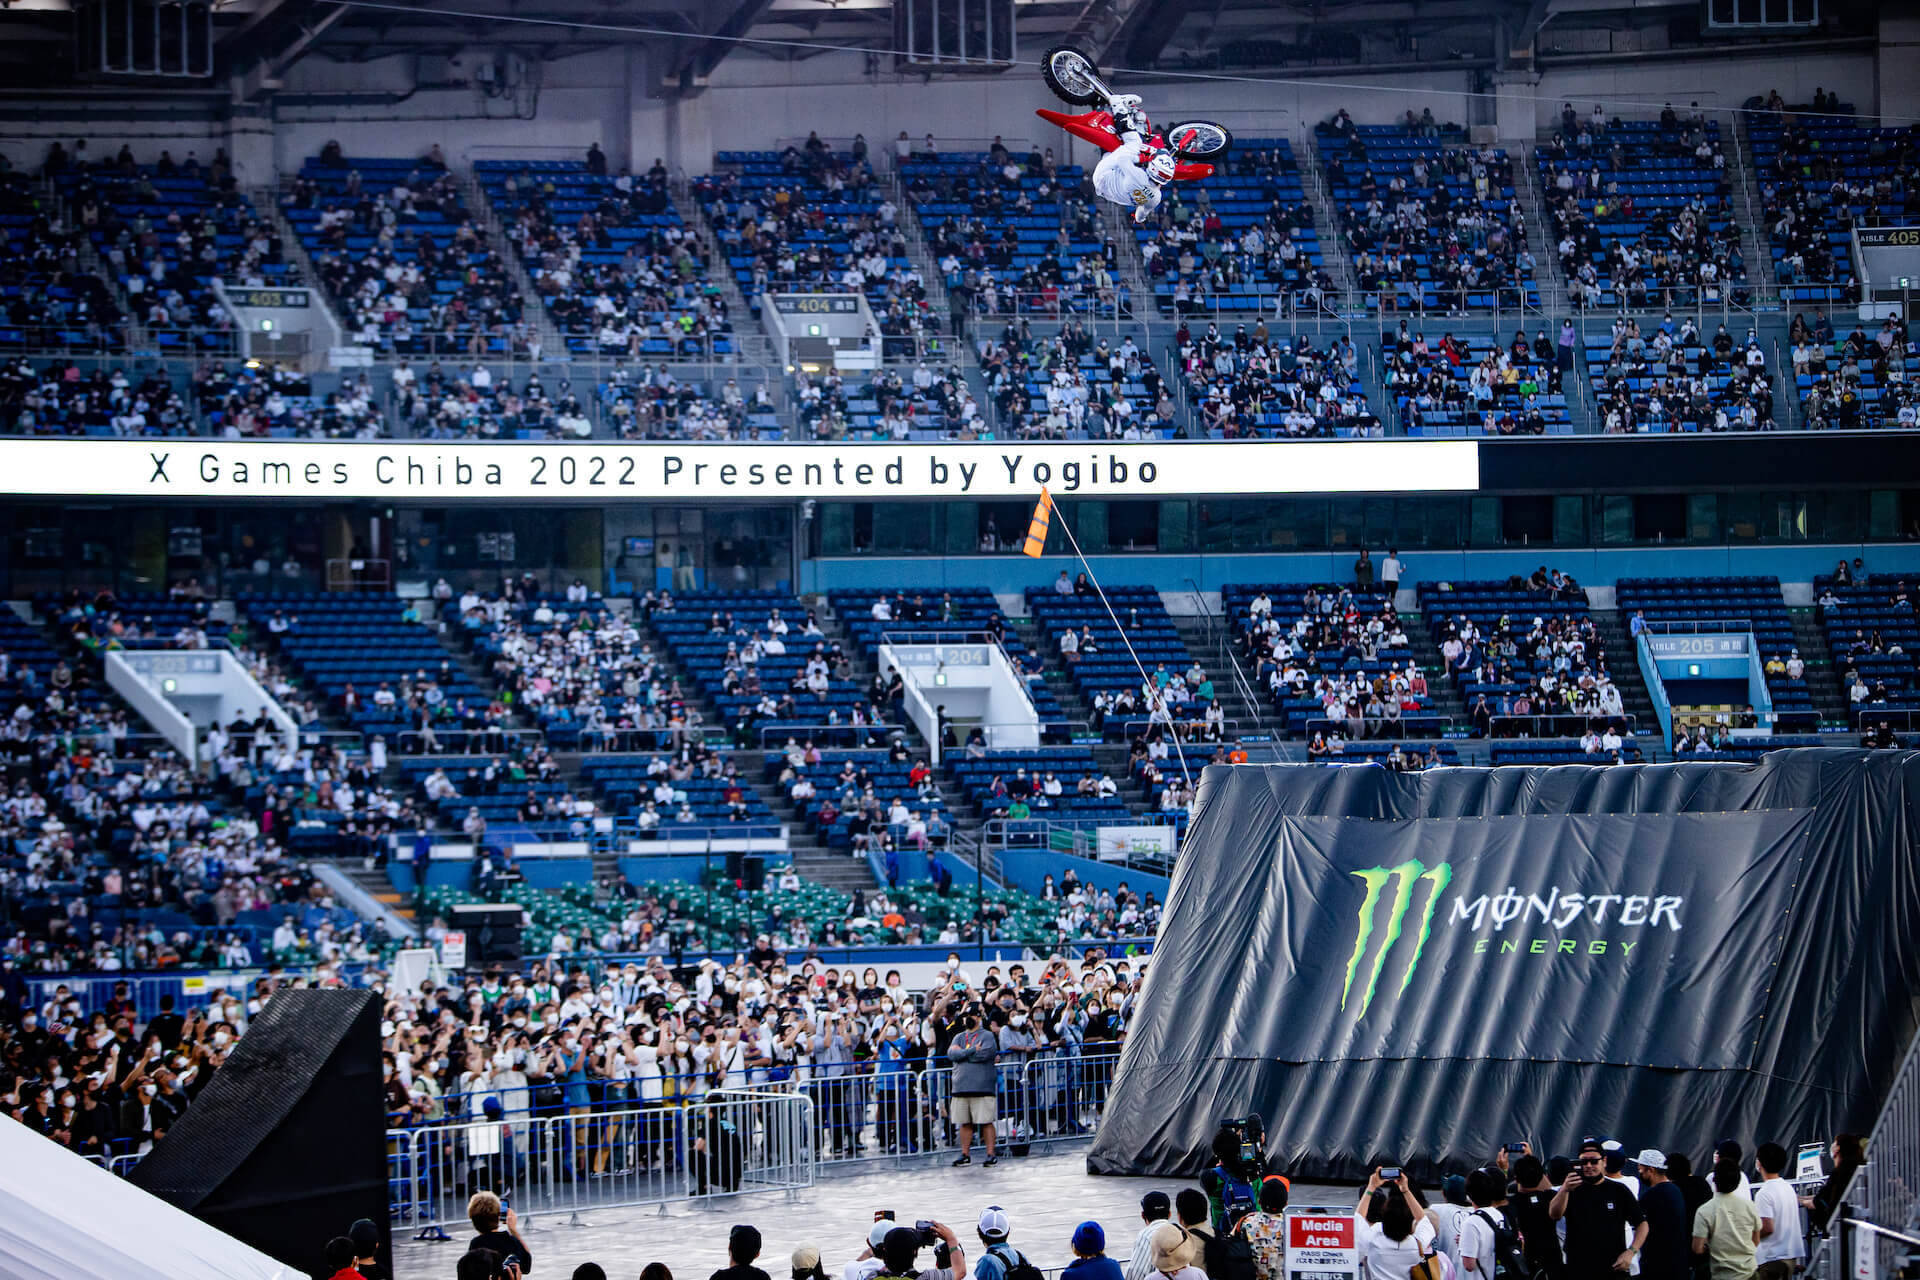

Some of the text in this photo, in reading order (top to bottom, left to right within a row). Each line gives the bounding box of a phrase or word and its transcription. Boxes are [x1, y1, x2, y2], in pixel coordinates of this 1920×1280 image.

[1860, 231, 1919, 244] AISLE 405
[798, 299, 831, 312] 404
[150, 453, 1157, 491] X Games Chiba 2022 Presented by Yogibo
[1680, 639, 1714, 653] 205
[949, 650, 983, 664] 204
[1473, 939, 1638, 956] ENERGY
[1302, 1220, 1344, 1231] Media
[1305, 1235, 1340, 1246] Area
